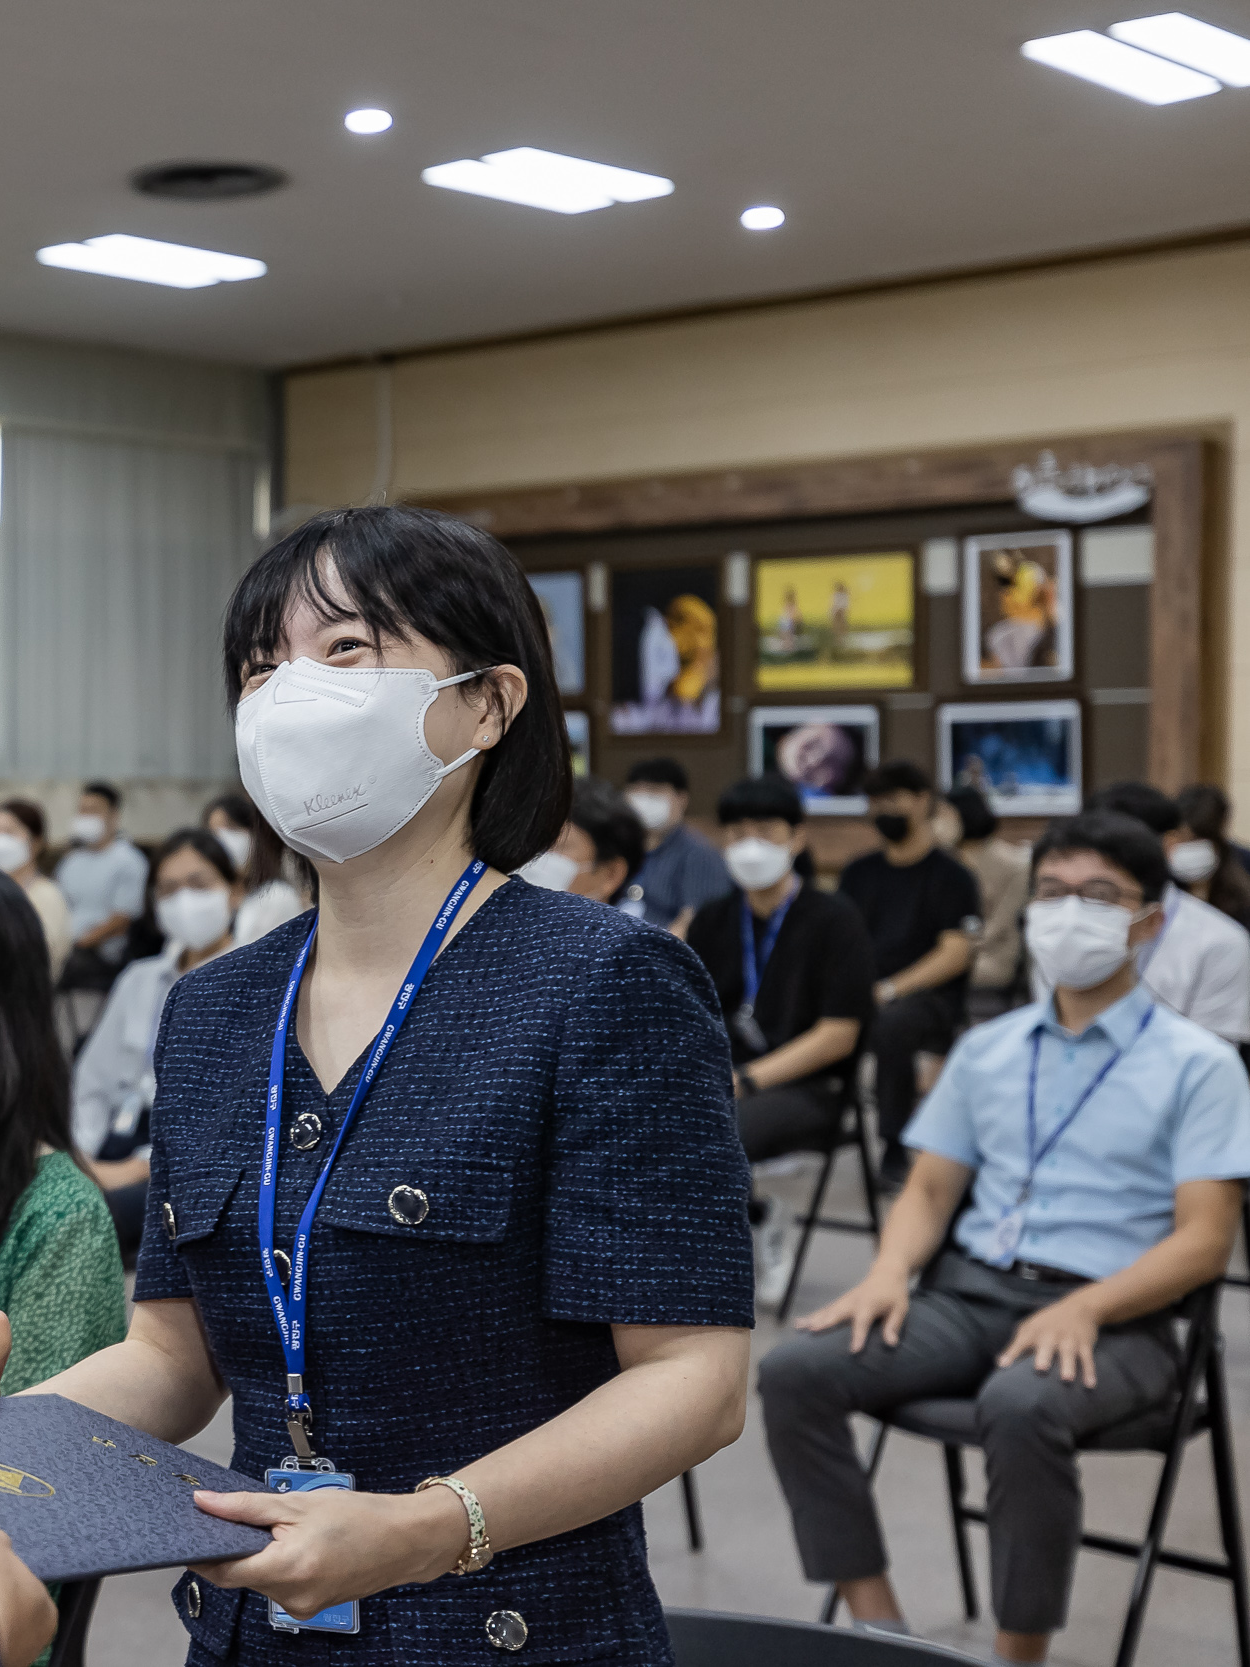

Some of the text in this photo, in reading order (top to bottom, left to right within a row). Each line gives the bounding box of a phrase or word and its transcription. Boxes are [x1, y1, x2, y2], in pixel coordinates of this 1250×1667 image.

[303, 782, 367, 816] Kleenex
[435, 879, 469, 931] GWANGJIN-GU
[397, 982, 416, 1011] 광진구
[364, 1023, 395, 1083] GWANGJIN-GU
[269, 1084, 279, 1111] 광진구
[263, 1126, 276, 1187] GWANGJIN-GU
[262, 1247, 274, 1279] 광진구
[291, 1233, 306, 1351] GWANGJIN-GU 광진구
